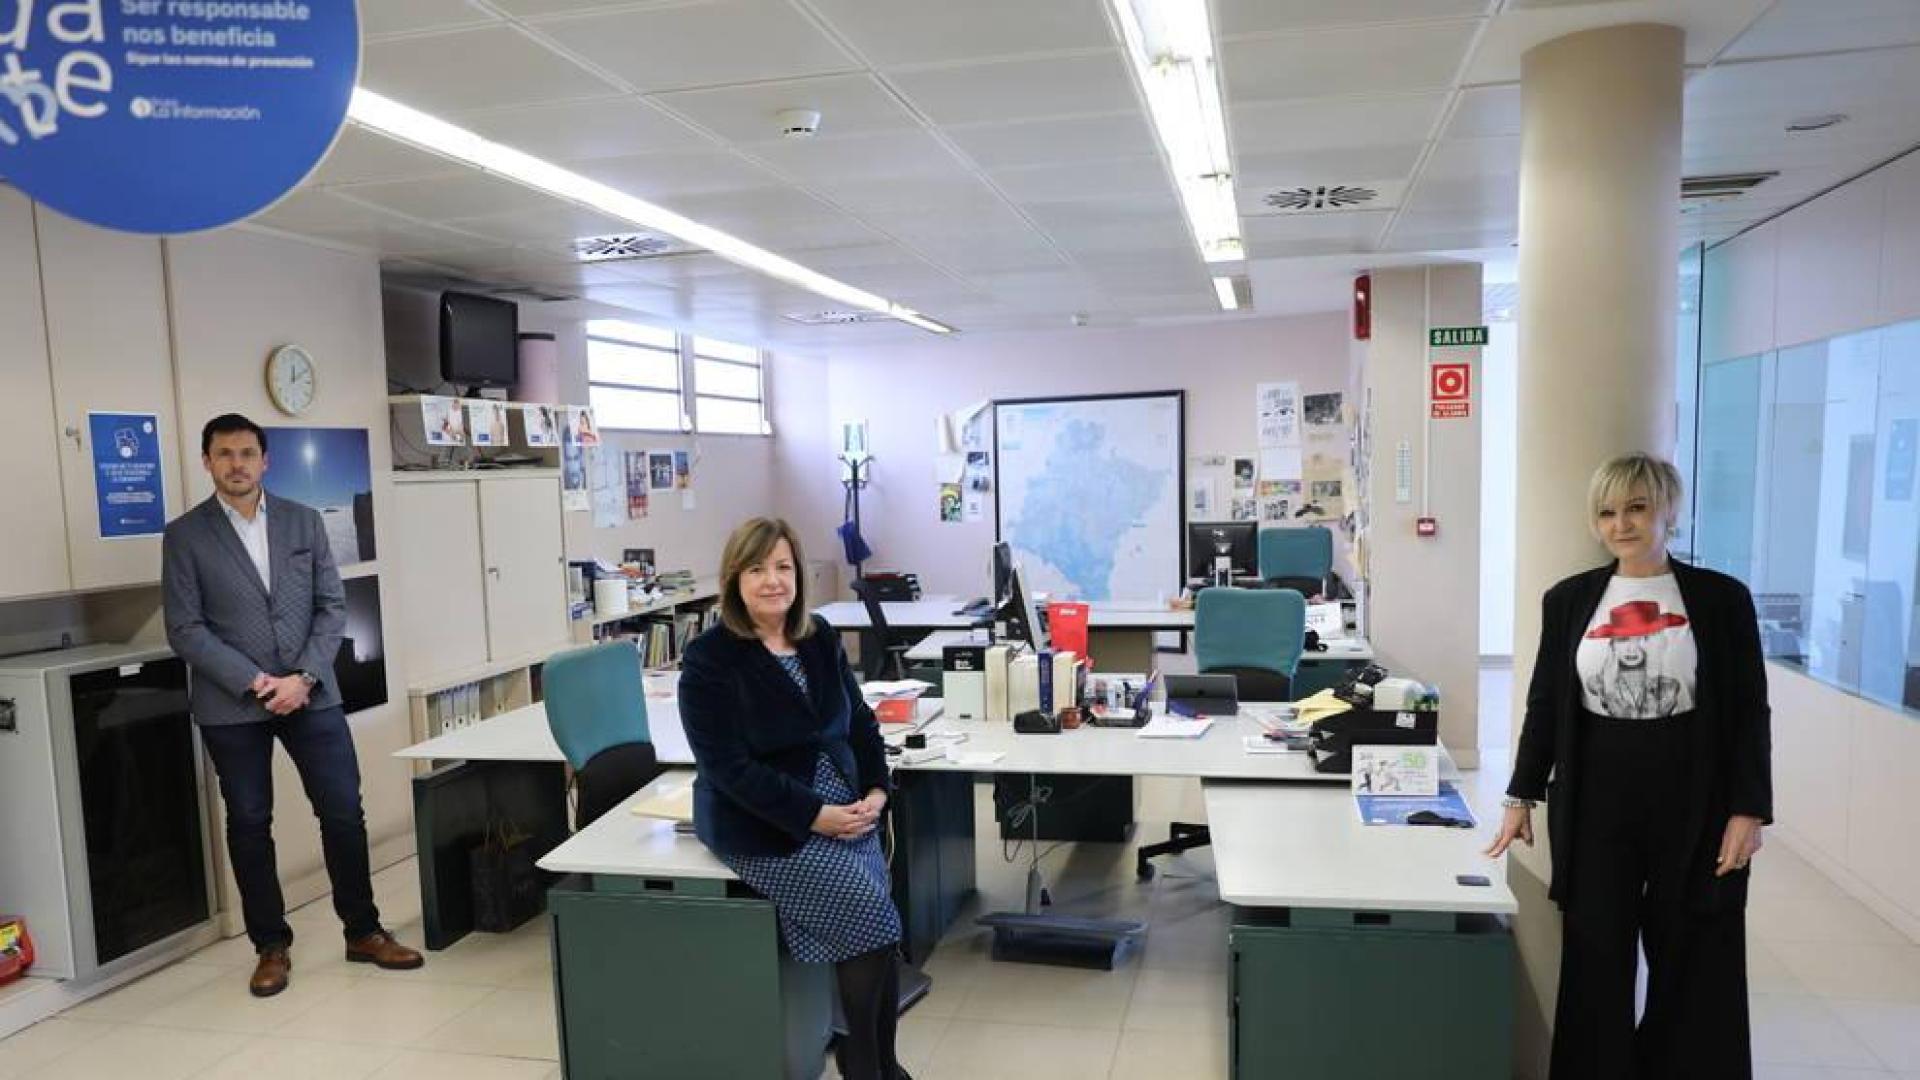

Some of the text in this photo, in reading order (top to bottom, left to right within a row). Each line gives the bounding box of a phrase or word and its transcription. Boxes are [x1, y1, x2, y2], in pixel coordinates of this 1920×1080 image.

[122, 0, 310, 20] Ser responsable
[123, 25, 276, 47] nos beneficia
[1434, 328, 1483, 344] SALIDA
